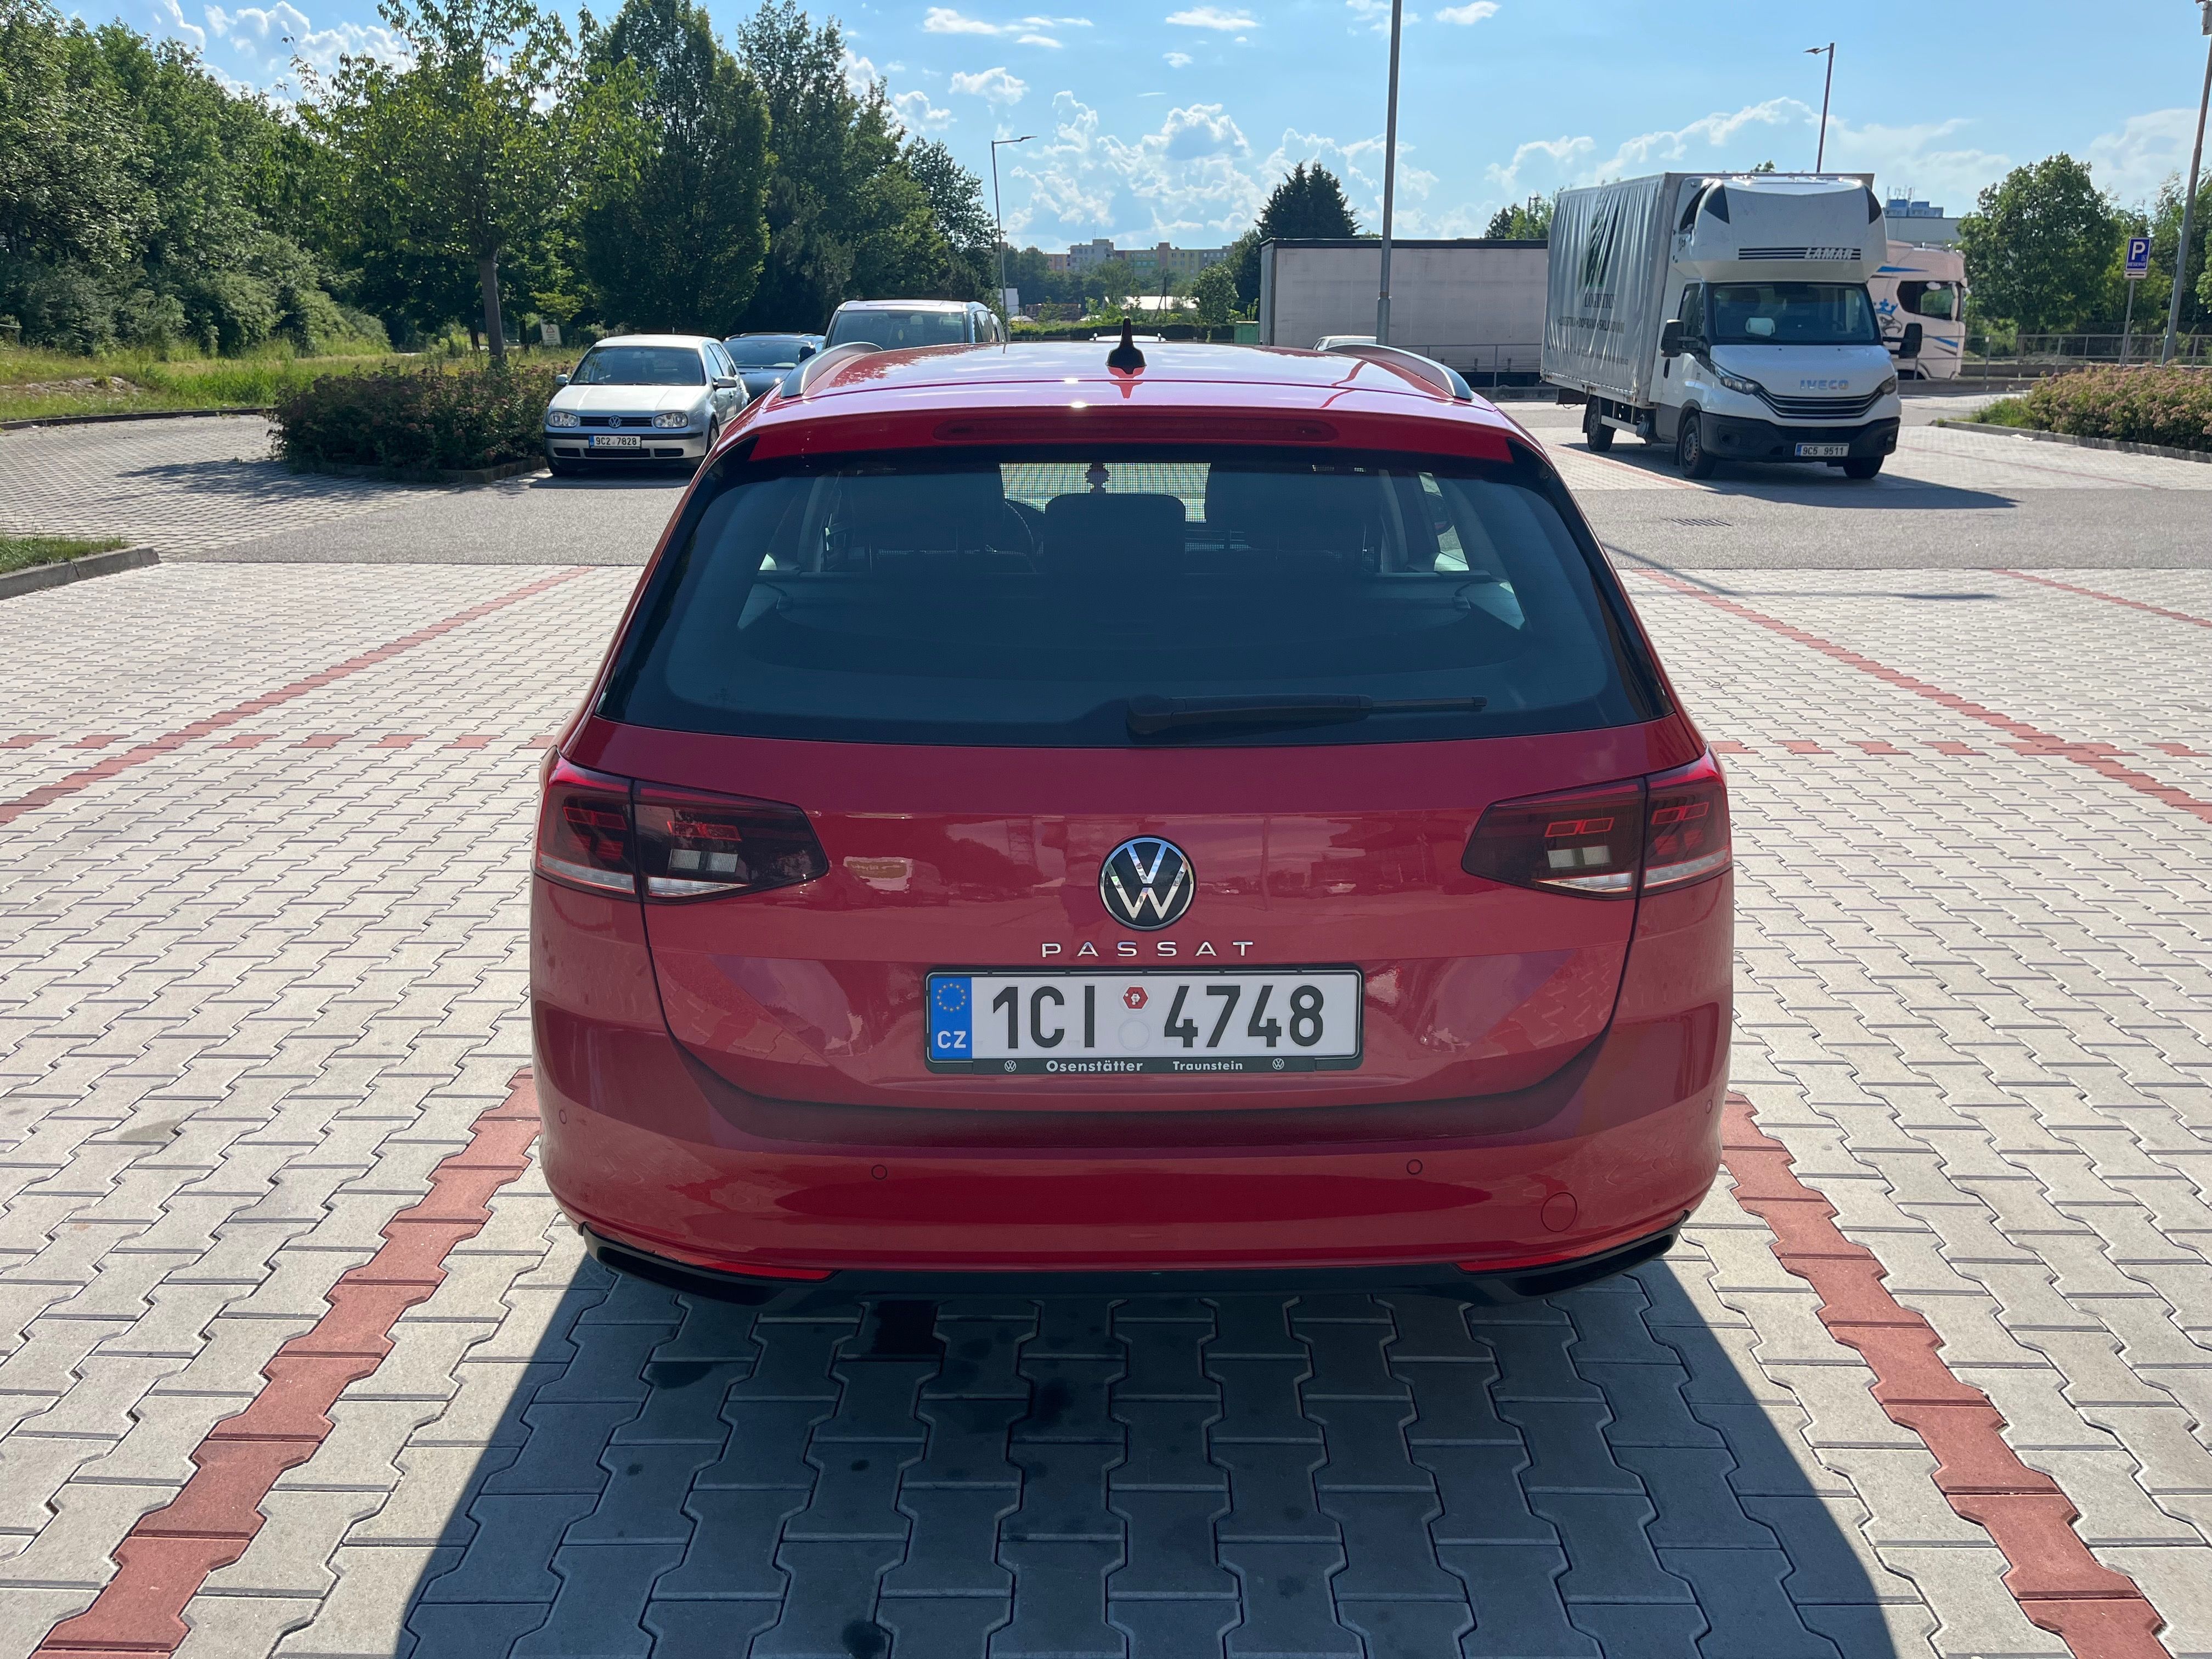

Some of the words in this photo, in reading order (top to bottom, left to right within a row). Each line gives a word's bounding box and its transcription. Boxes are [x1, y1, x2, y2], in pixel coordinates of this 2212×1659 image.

[1805, 247, 1853, 259] LAMAR
[2131, 241, 2146, 260] P
[1800, 379, 1849, 391] IVECO
[596, 437, 611, 445] 9C2
[617, 437, 636, 445] 7828
[1042, 941, 1254, 957] PASSAT
[992, 985, 1095, 1048] 1CI
[1164, 985, 1324, 1048] 4748
[938, 1030, 966, 1048] CZ
[1046, 1060, 1143, 1073] Osenstätter
[1172, 1060, 1243, 1070] Traunstein
